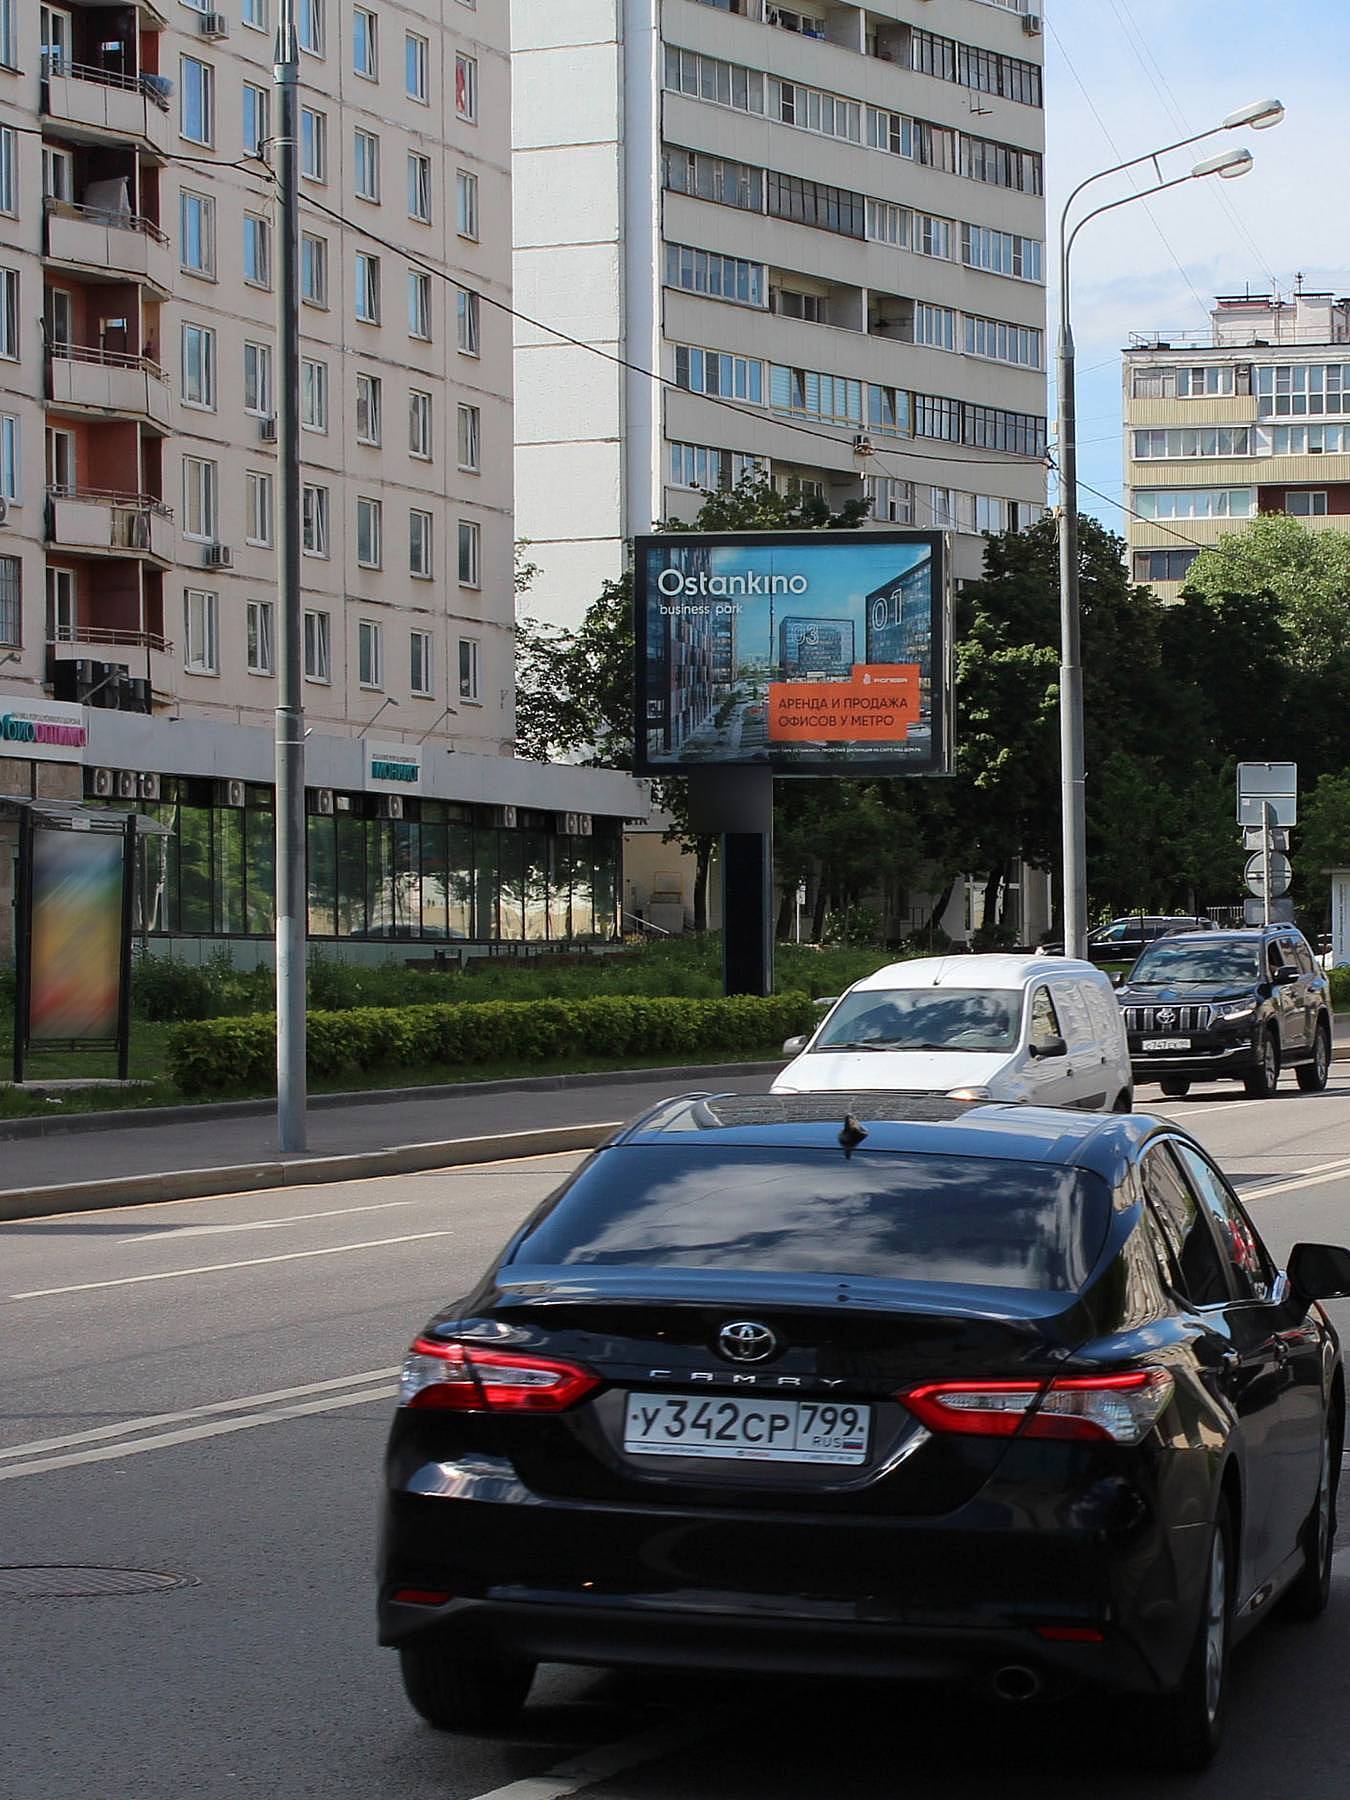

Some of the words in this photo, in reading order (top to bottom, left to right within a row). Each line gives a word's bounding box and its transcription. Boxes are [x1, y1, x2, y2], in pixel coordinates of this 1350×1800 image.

[657, 568, 808, 597] Ostankino
[659, 603, 710, 615] business
[715, 603, 743, 617] park
[872, 588, 902, 631] 01
[778, 697, 828, 711] АРЕНДА
[831, 698, 841, 710] И
[843, 697, 908, 711] ПРОДАЖА
[778, 714, 838, 728] ОФИСОВ
[840, 715, 850, 728] У
[851, 714, 896, 727] МЕТРО
[650, 1369, 847, 1388] CAMRY
[801, 1404, 859, 1437] 799
[813, 1436, 841, 1448] RUS
